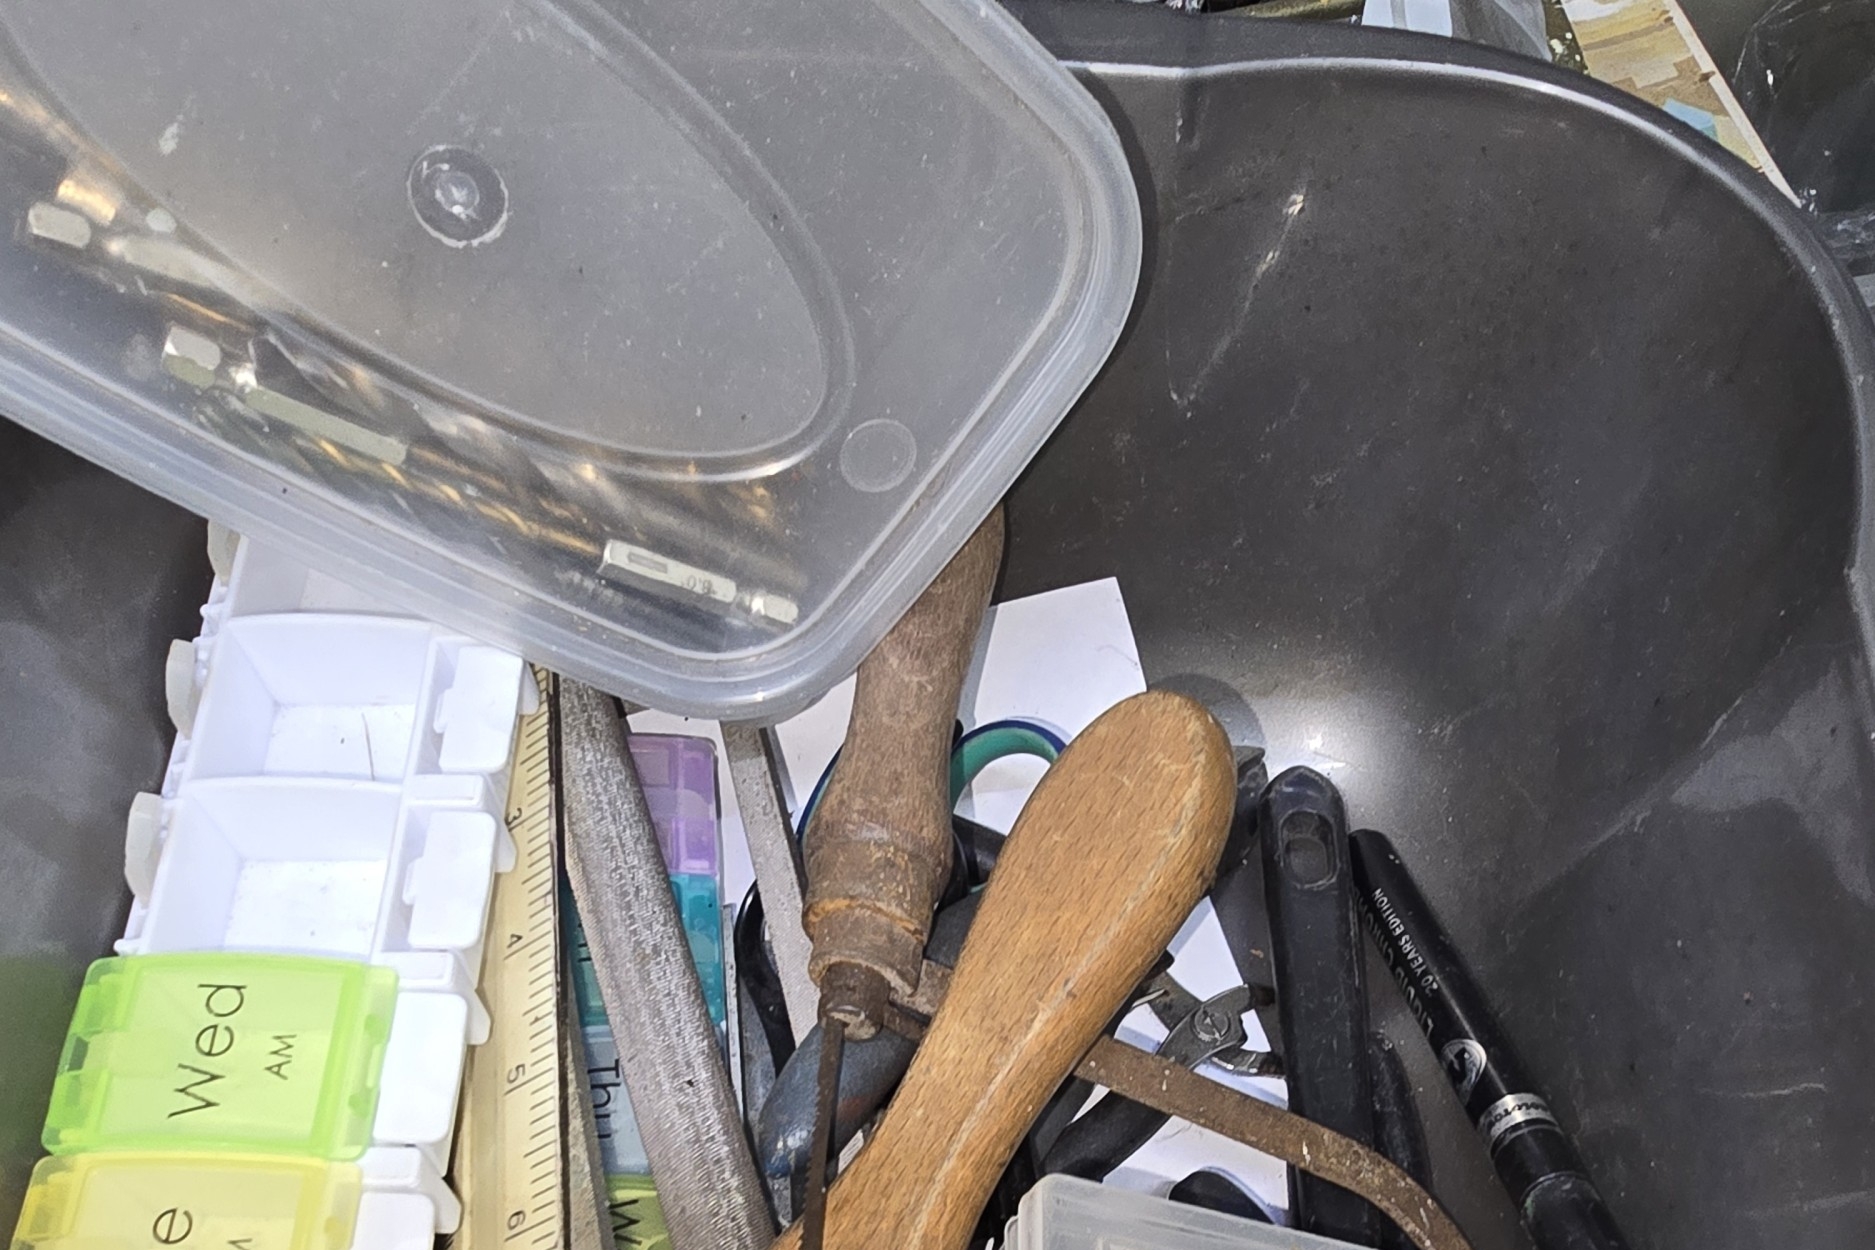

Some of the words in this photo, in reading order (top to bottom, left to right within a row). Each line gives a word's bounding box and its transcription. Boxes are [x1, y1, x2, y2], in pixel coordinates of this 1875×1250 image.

[1372, 887, 1405, 936] EDITION
[507, 933, 523, 949] 4
[1398, 934, 1427, 977] YEARS
[1421, 975, 1438, 997] 20
[168, 983, 247, 1119] Wed
[264, 1033, 297, 1079] AM
[507, 1064, 525, 1085] 5
[507, 1209, 526, 1232] 6
